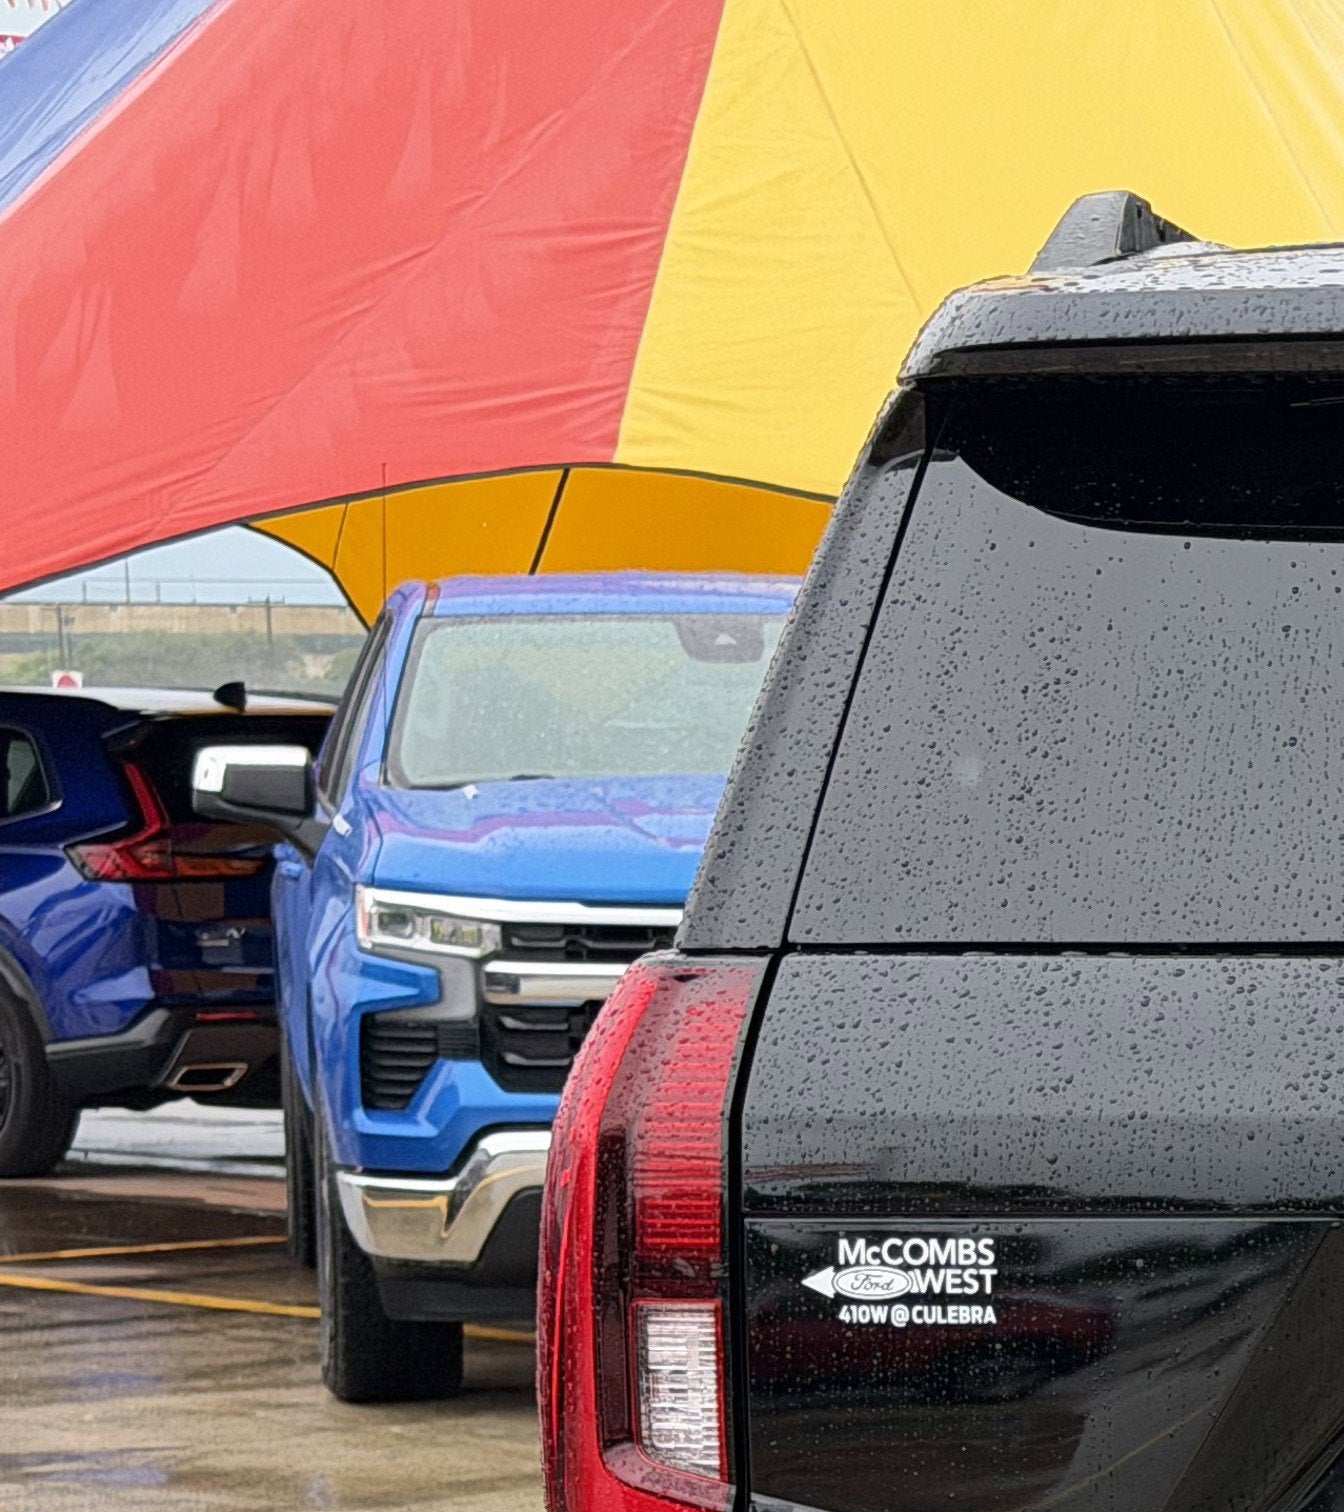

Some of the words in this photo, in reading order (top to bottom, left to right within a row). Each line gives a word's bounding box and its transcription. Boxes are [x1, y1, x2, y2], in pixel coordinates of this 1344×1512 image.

[838, 1238, 995, 1266] McCOMBS
[851, 1273, 894, 1292] Ford
[911, 1268, 998, 1295] WEST
